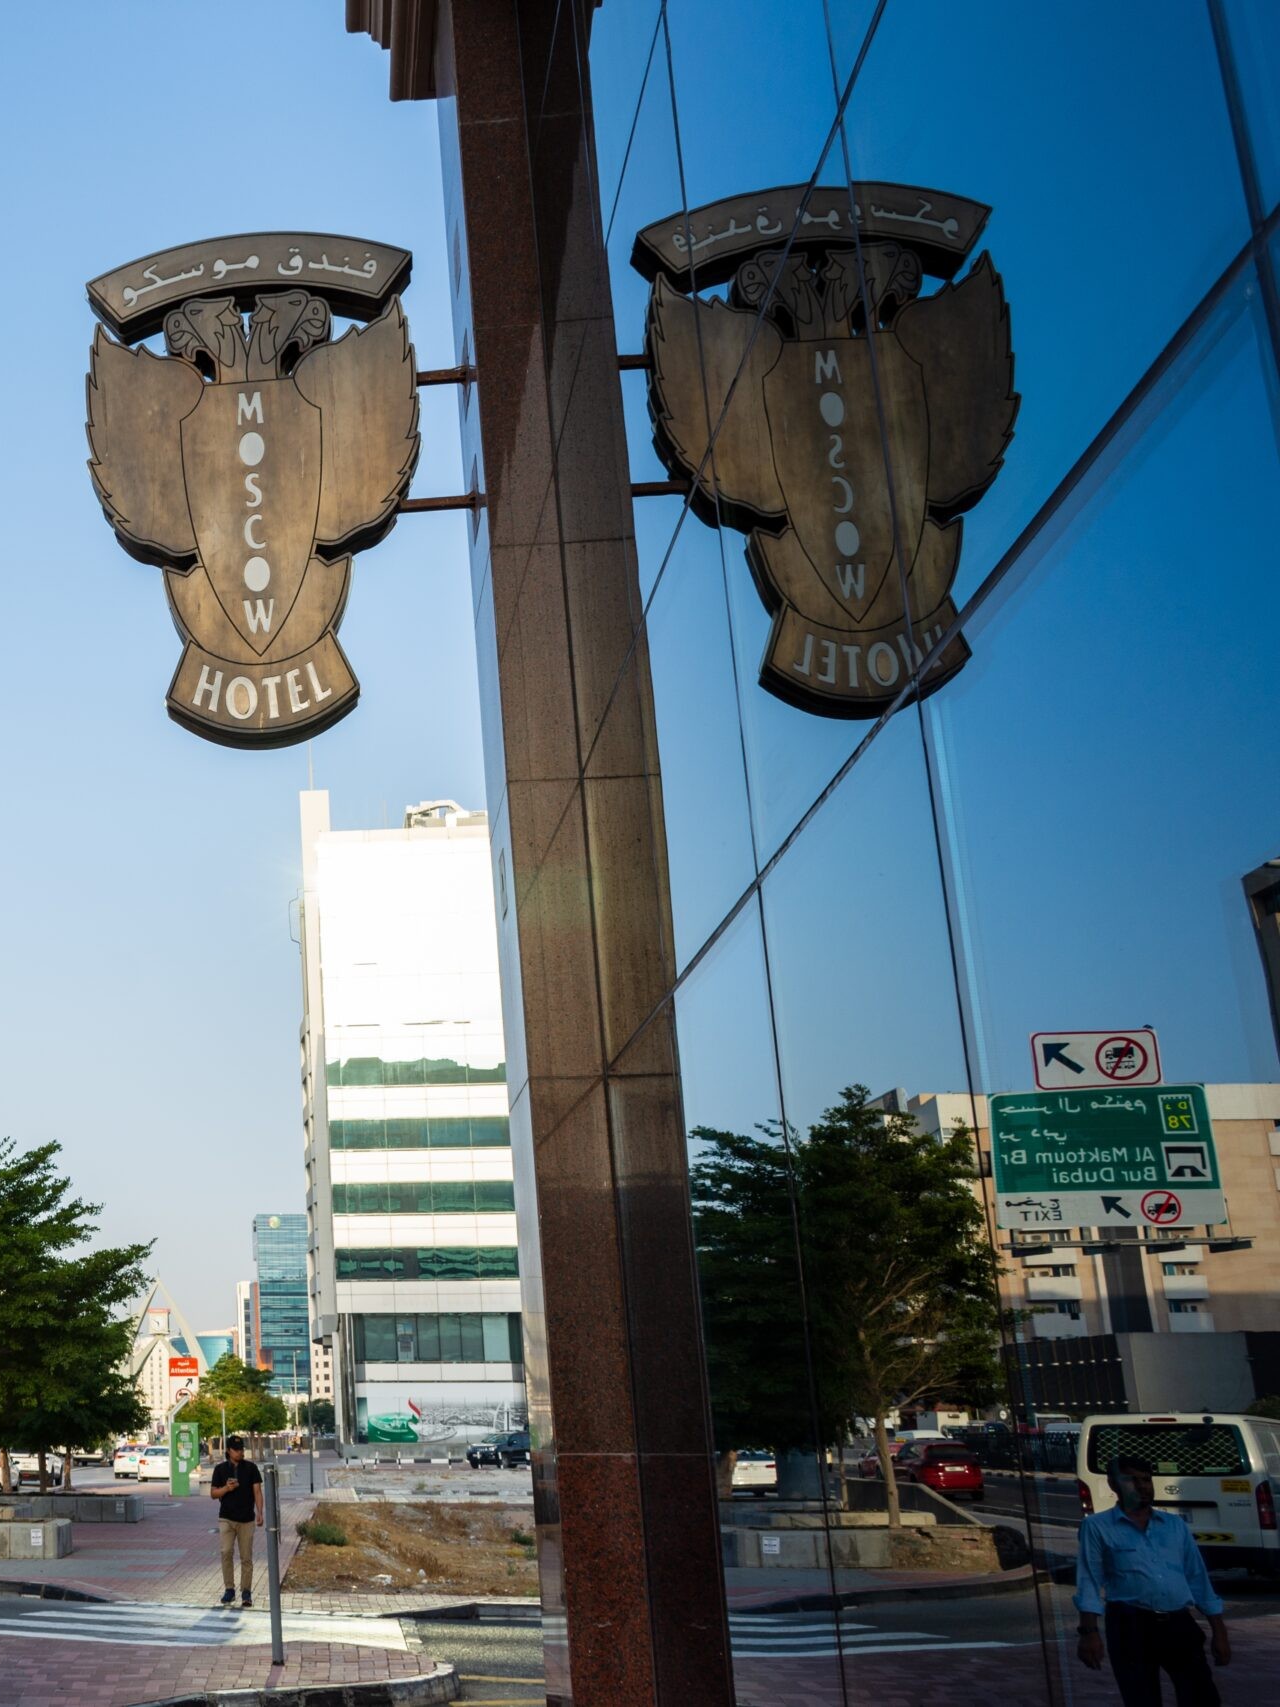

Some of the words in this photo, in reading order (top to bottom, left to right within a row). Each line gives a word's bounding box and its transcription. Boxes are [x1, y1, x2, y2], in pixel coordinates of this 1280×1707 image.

[122, 254, 261, 308] موسكو
[277, 248, 378, 279] فندق
[236, 391, 276, 635] MOSCOW
[192, 660, 333, 721] HOTEL
